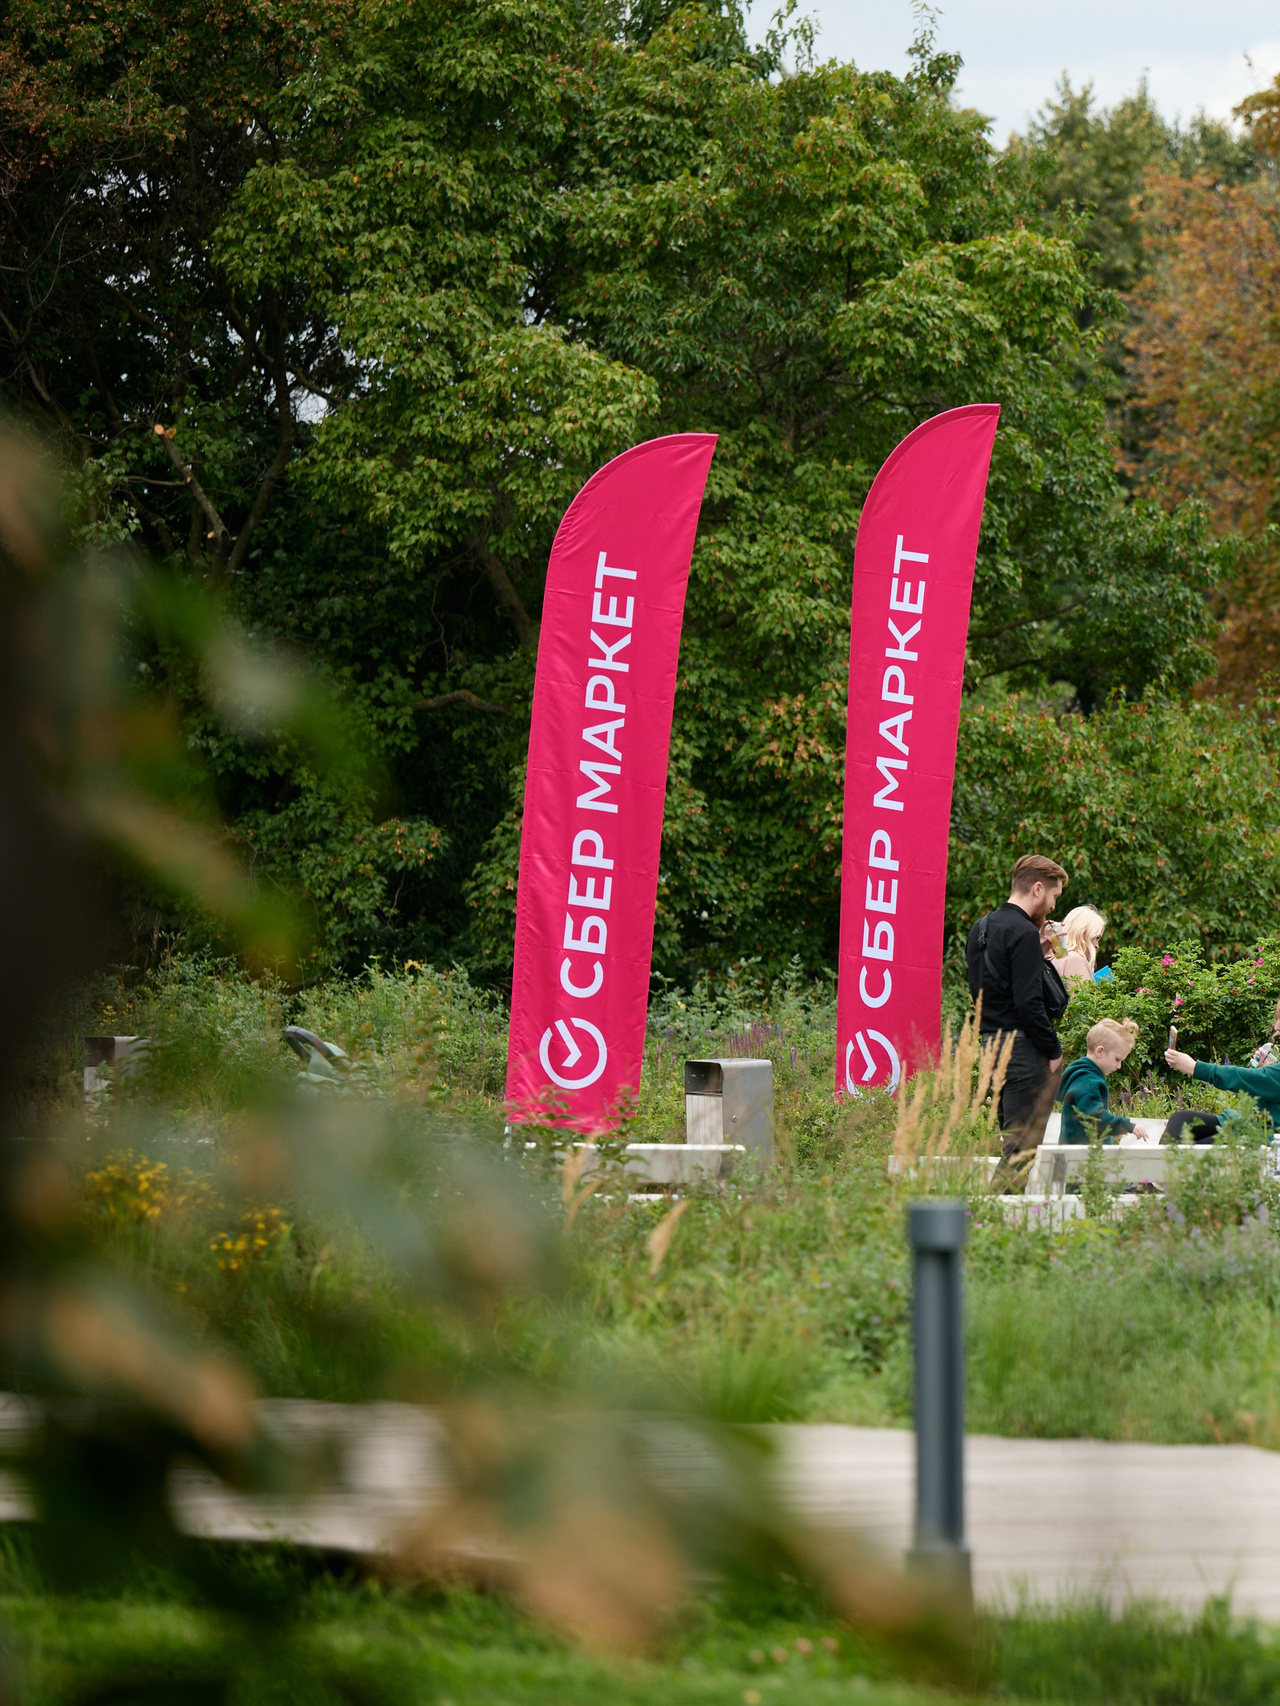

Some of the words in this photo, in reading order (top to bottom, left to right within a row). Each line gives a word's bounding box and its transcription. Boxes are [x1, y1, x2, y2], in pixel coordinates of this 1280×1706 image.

[576, 551, 638, 814] МАРКЕТ
[873, 534, 930, 812] МАРКЕТ
[559, 829, 614, 999] СБЕР
[859, 829, 900, 1009] СБЕР
